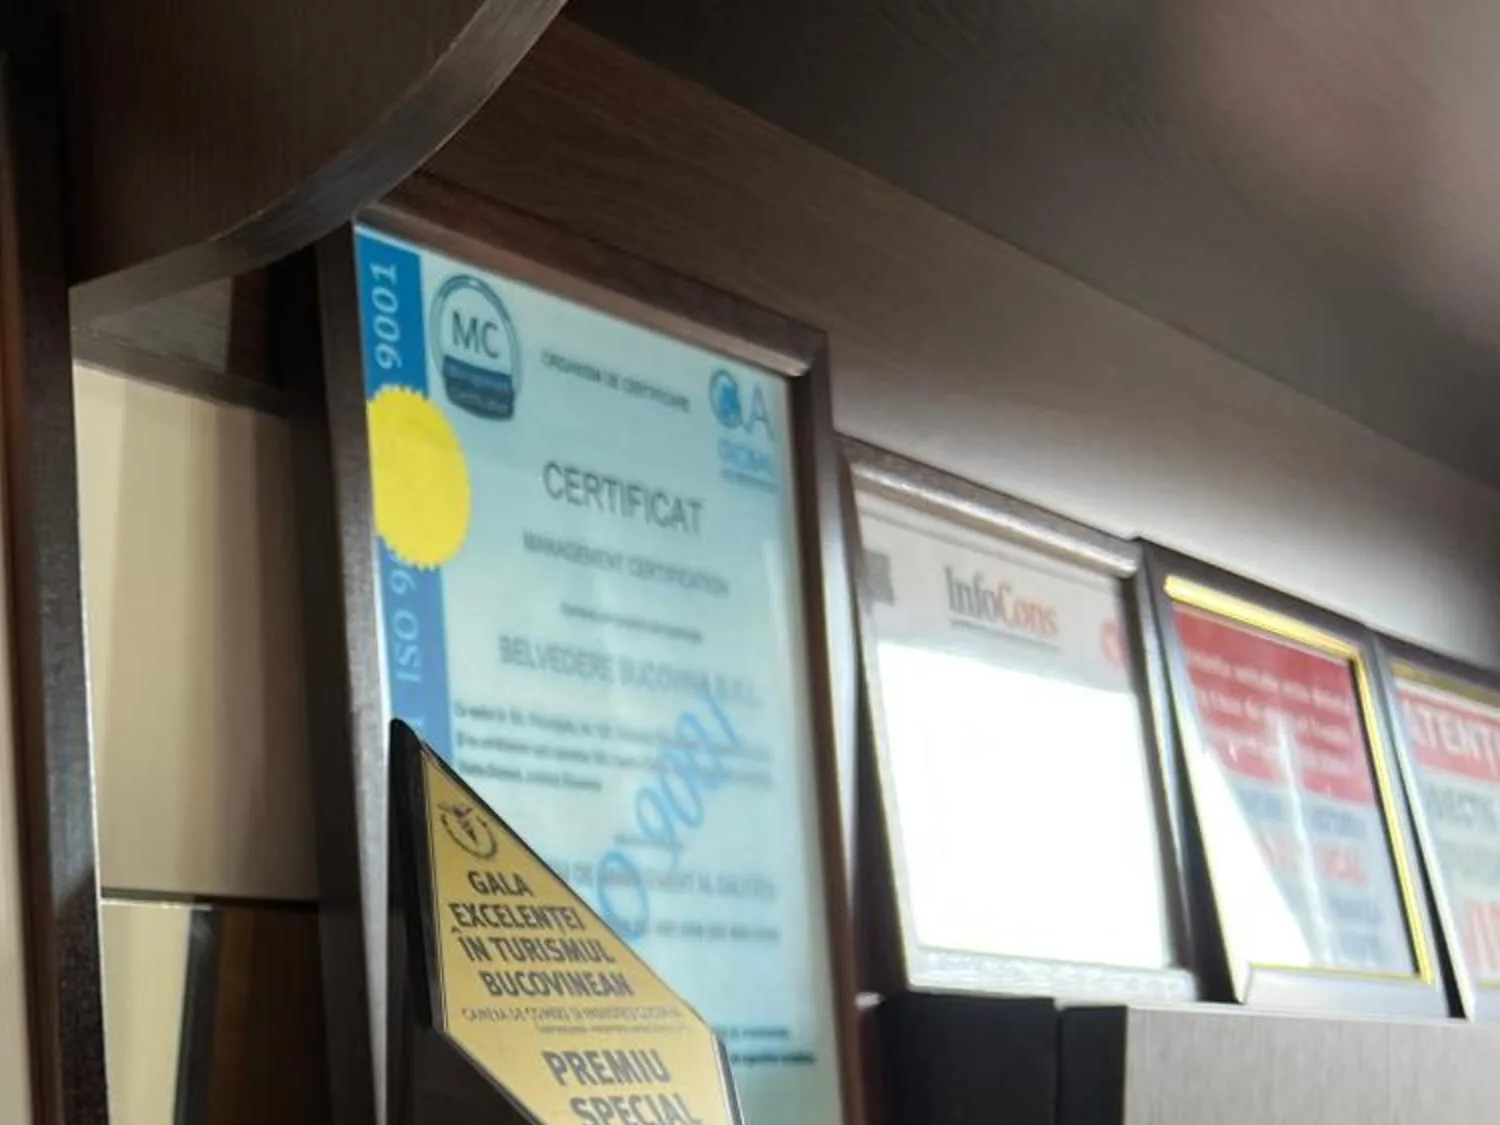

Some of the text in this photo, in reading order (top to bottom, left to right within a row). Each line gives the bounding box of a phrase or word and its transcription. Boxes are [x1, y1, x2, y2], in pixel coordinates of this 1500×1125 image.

[370, 263, 403, 370] 9001
[452, 310, 503, 359] MC
[541, 460, 702, 536] CERTIFICAT
[389, 608, 422, 682] ISO
[466, 870, 535, 898] GALA
[450, 925, 617, 964] ÎN TURISMUL
[479, 970, 635, 998] BUCOVINEAN
[541, 1049, 672, 1087] PREMIU
